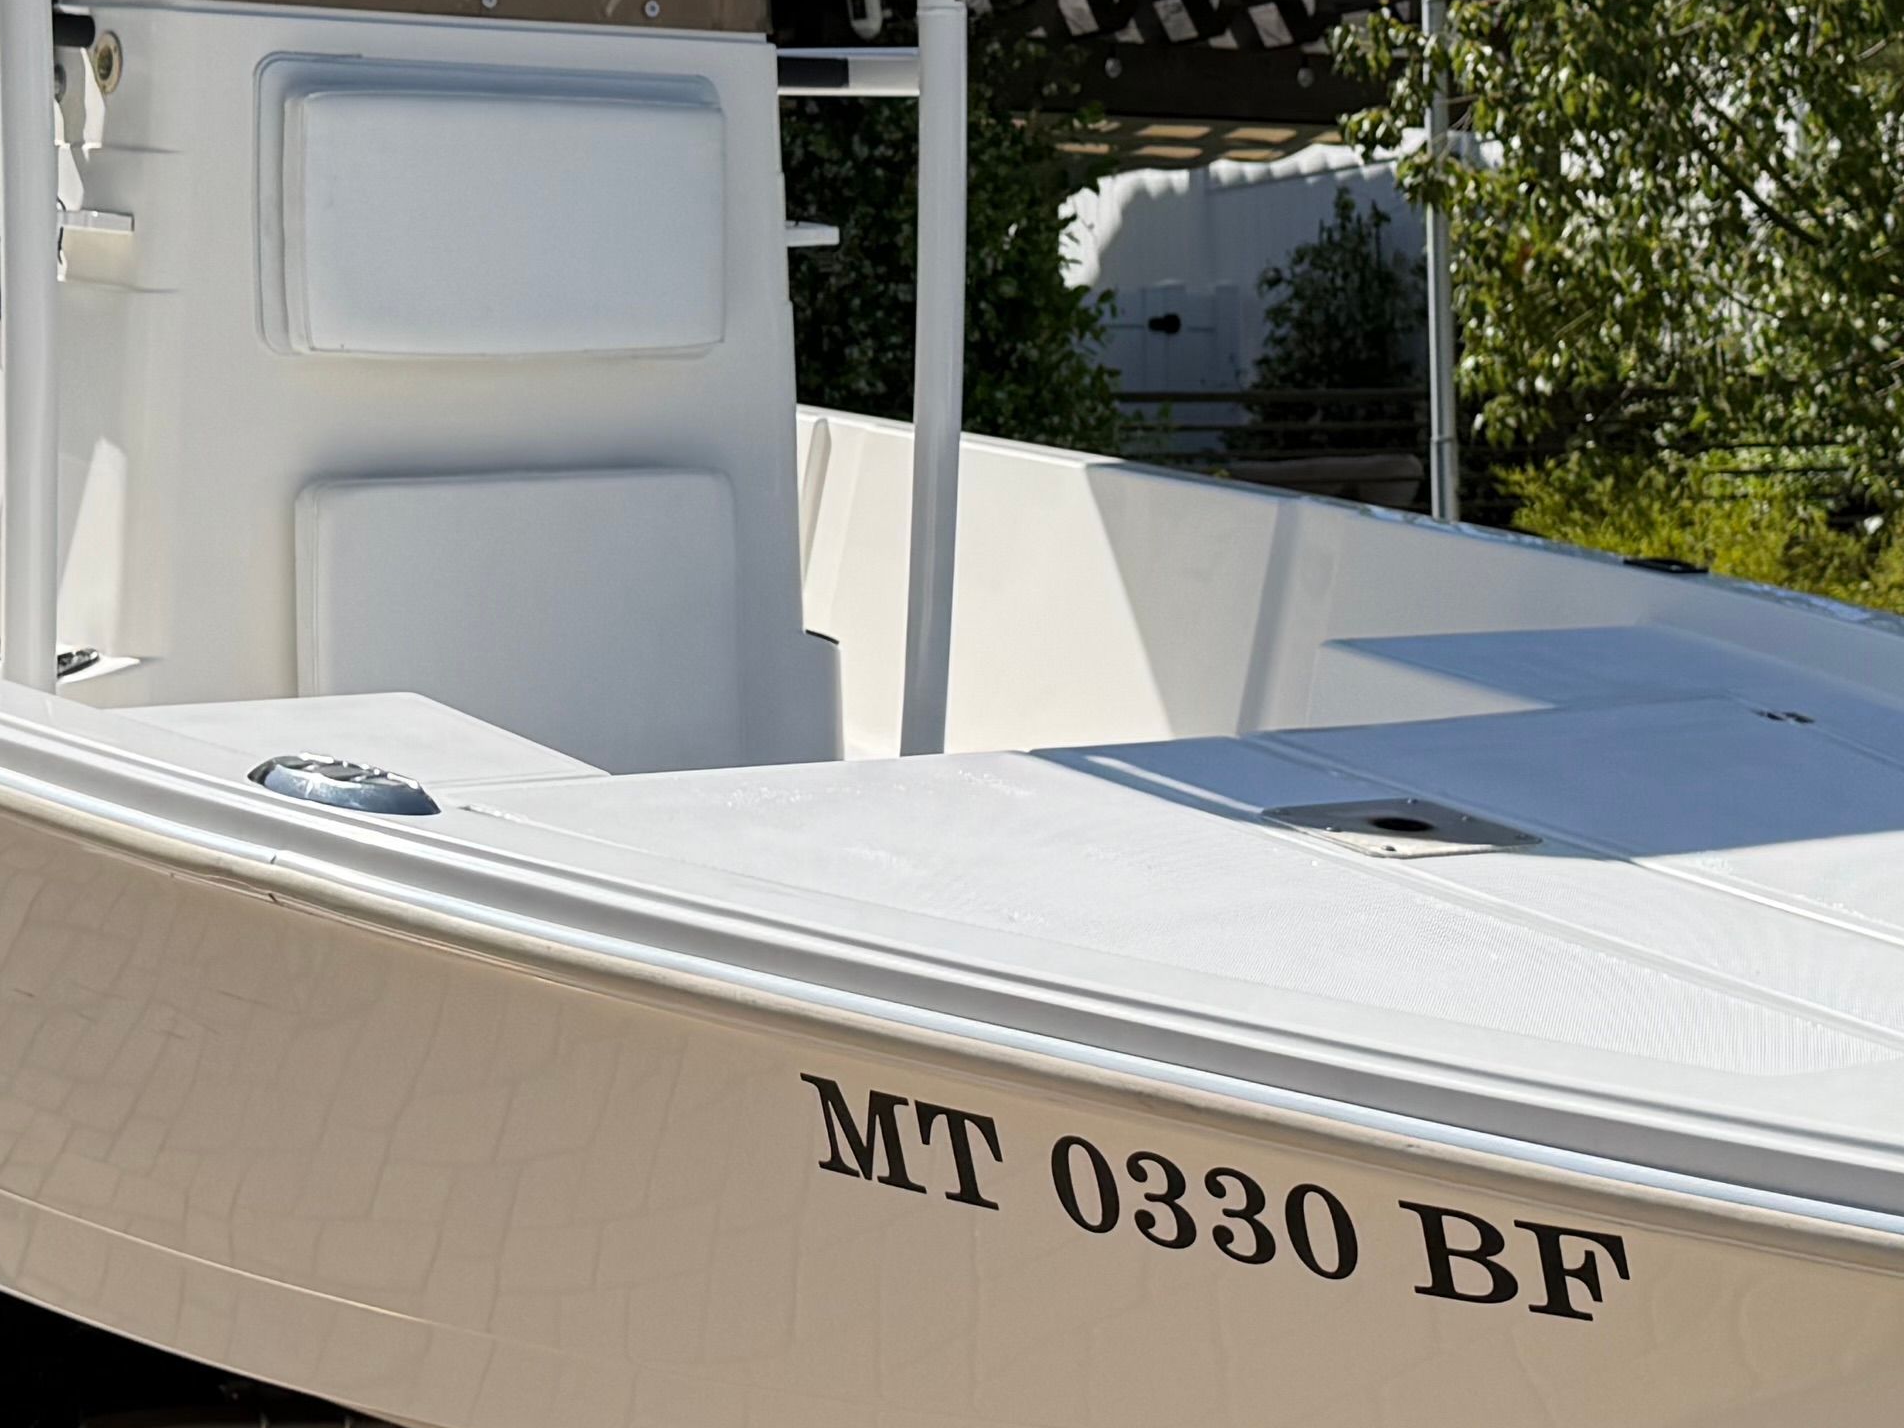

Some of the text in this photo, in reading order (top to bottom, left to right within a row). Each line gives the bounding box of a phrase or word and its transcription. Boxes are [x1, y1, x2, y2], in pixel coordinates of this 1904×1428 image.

[800, 1072, 1631, 1322] MT 0330 BF
